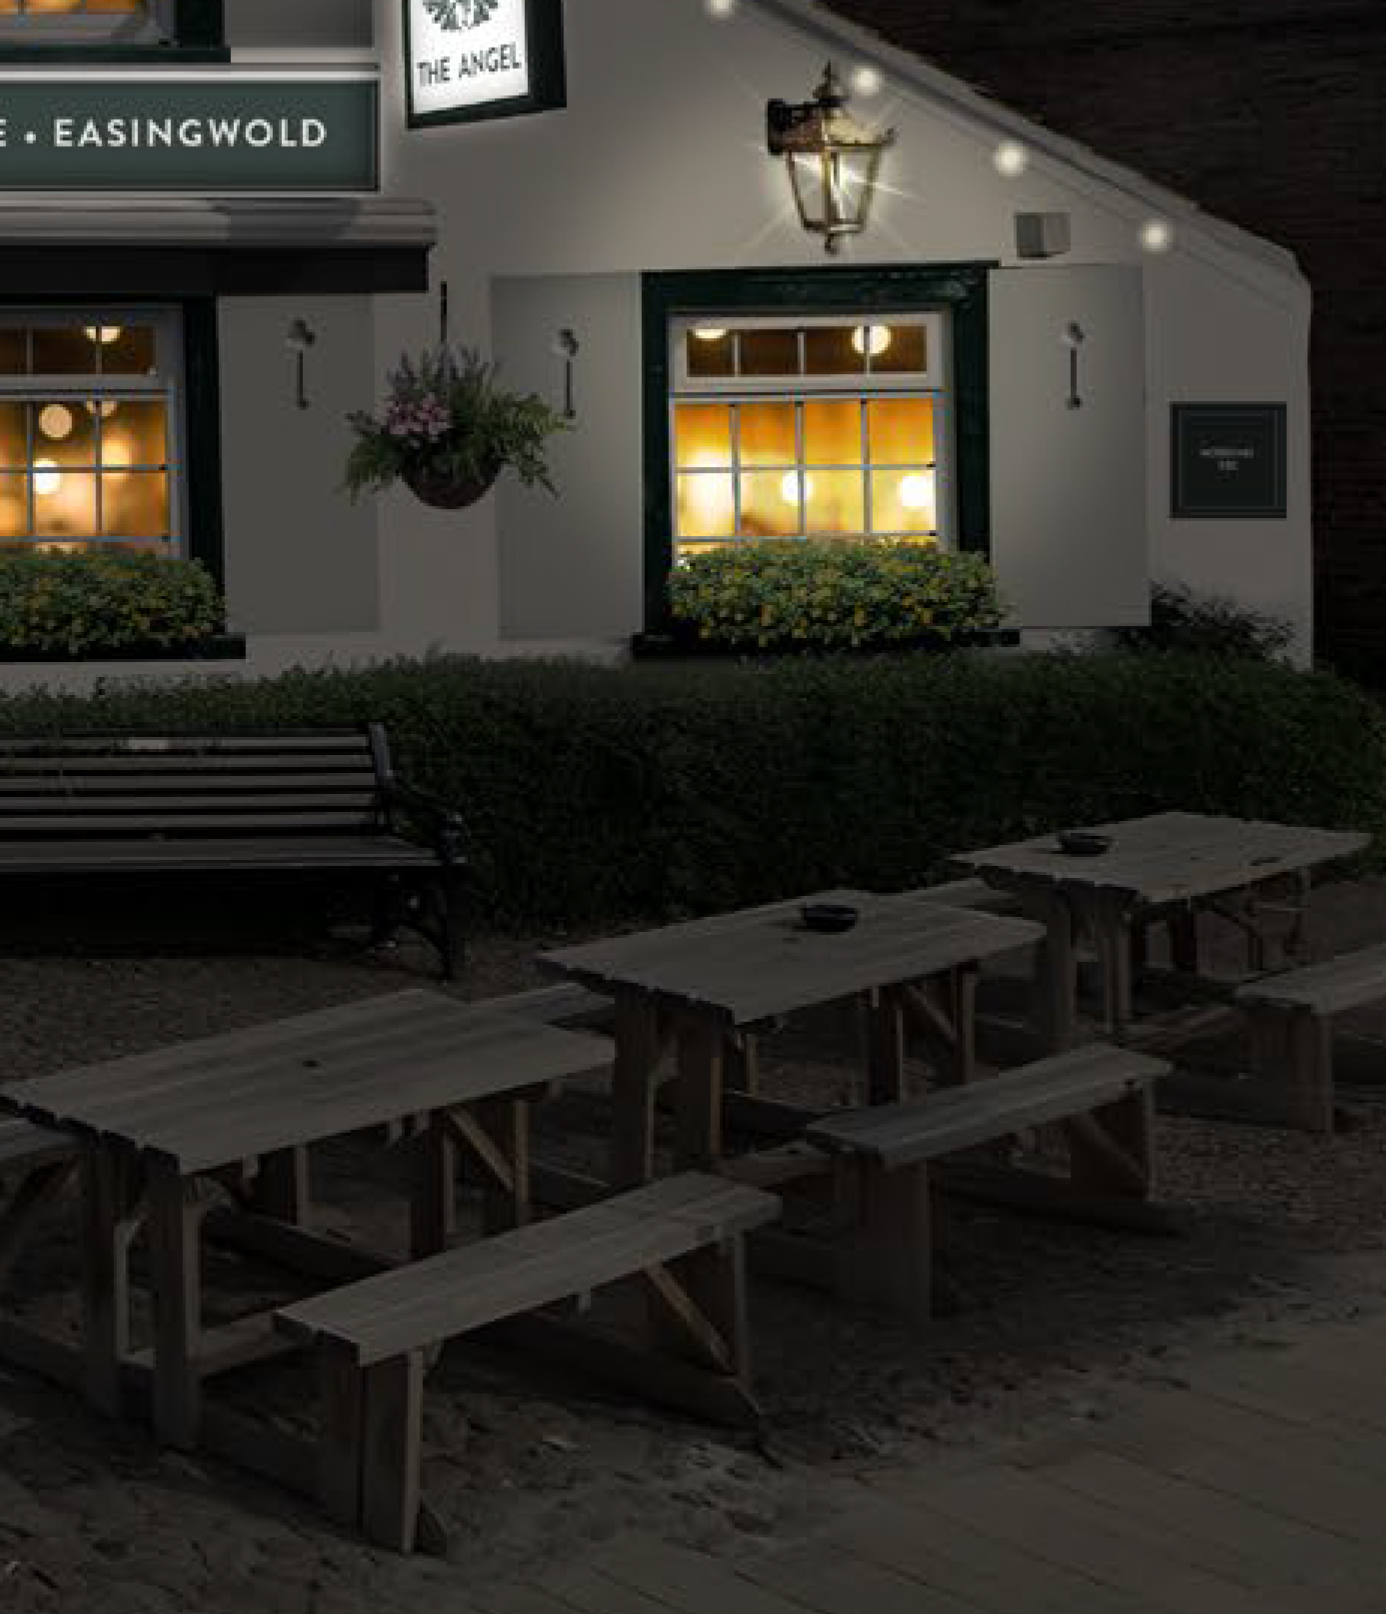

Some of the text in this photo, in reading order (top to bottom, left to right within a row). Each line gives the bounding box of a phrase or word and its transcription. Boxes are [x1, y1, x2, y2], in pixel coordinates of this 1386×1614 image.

[416, 43, 522, 87] THE ANGEL
[53, 118, 328, 148] EASINGWOLD
